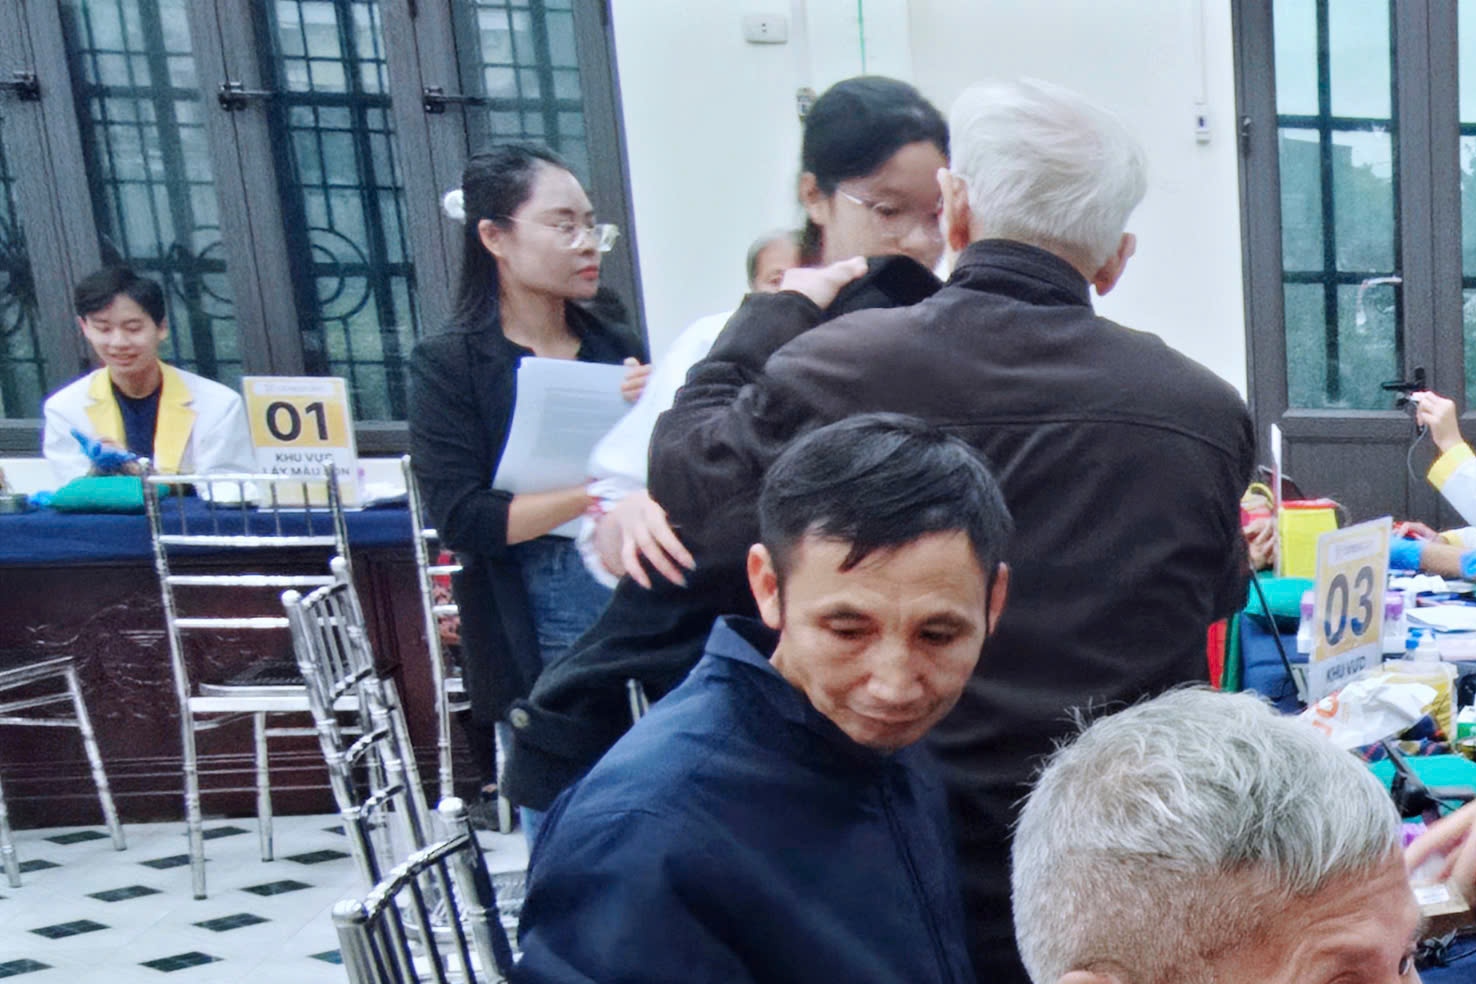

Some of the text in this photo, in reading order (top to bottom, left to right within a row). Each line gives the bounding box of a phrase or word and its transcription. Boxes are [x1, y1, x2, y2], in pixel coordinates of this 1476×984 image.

[266, 401, 329, 442] 01
[275, 453, 302, 463] KHU
[1324, 566, 1374, 646] 03
